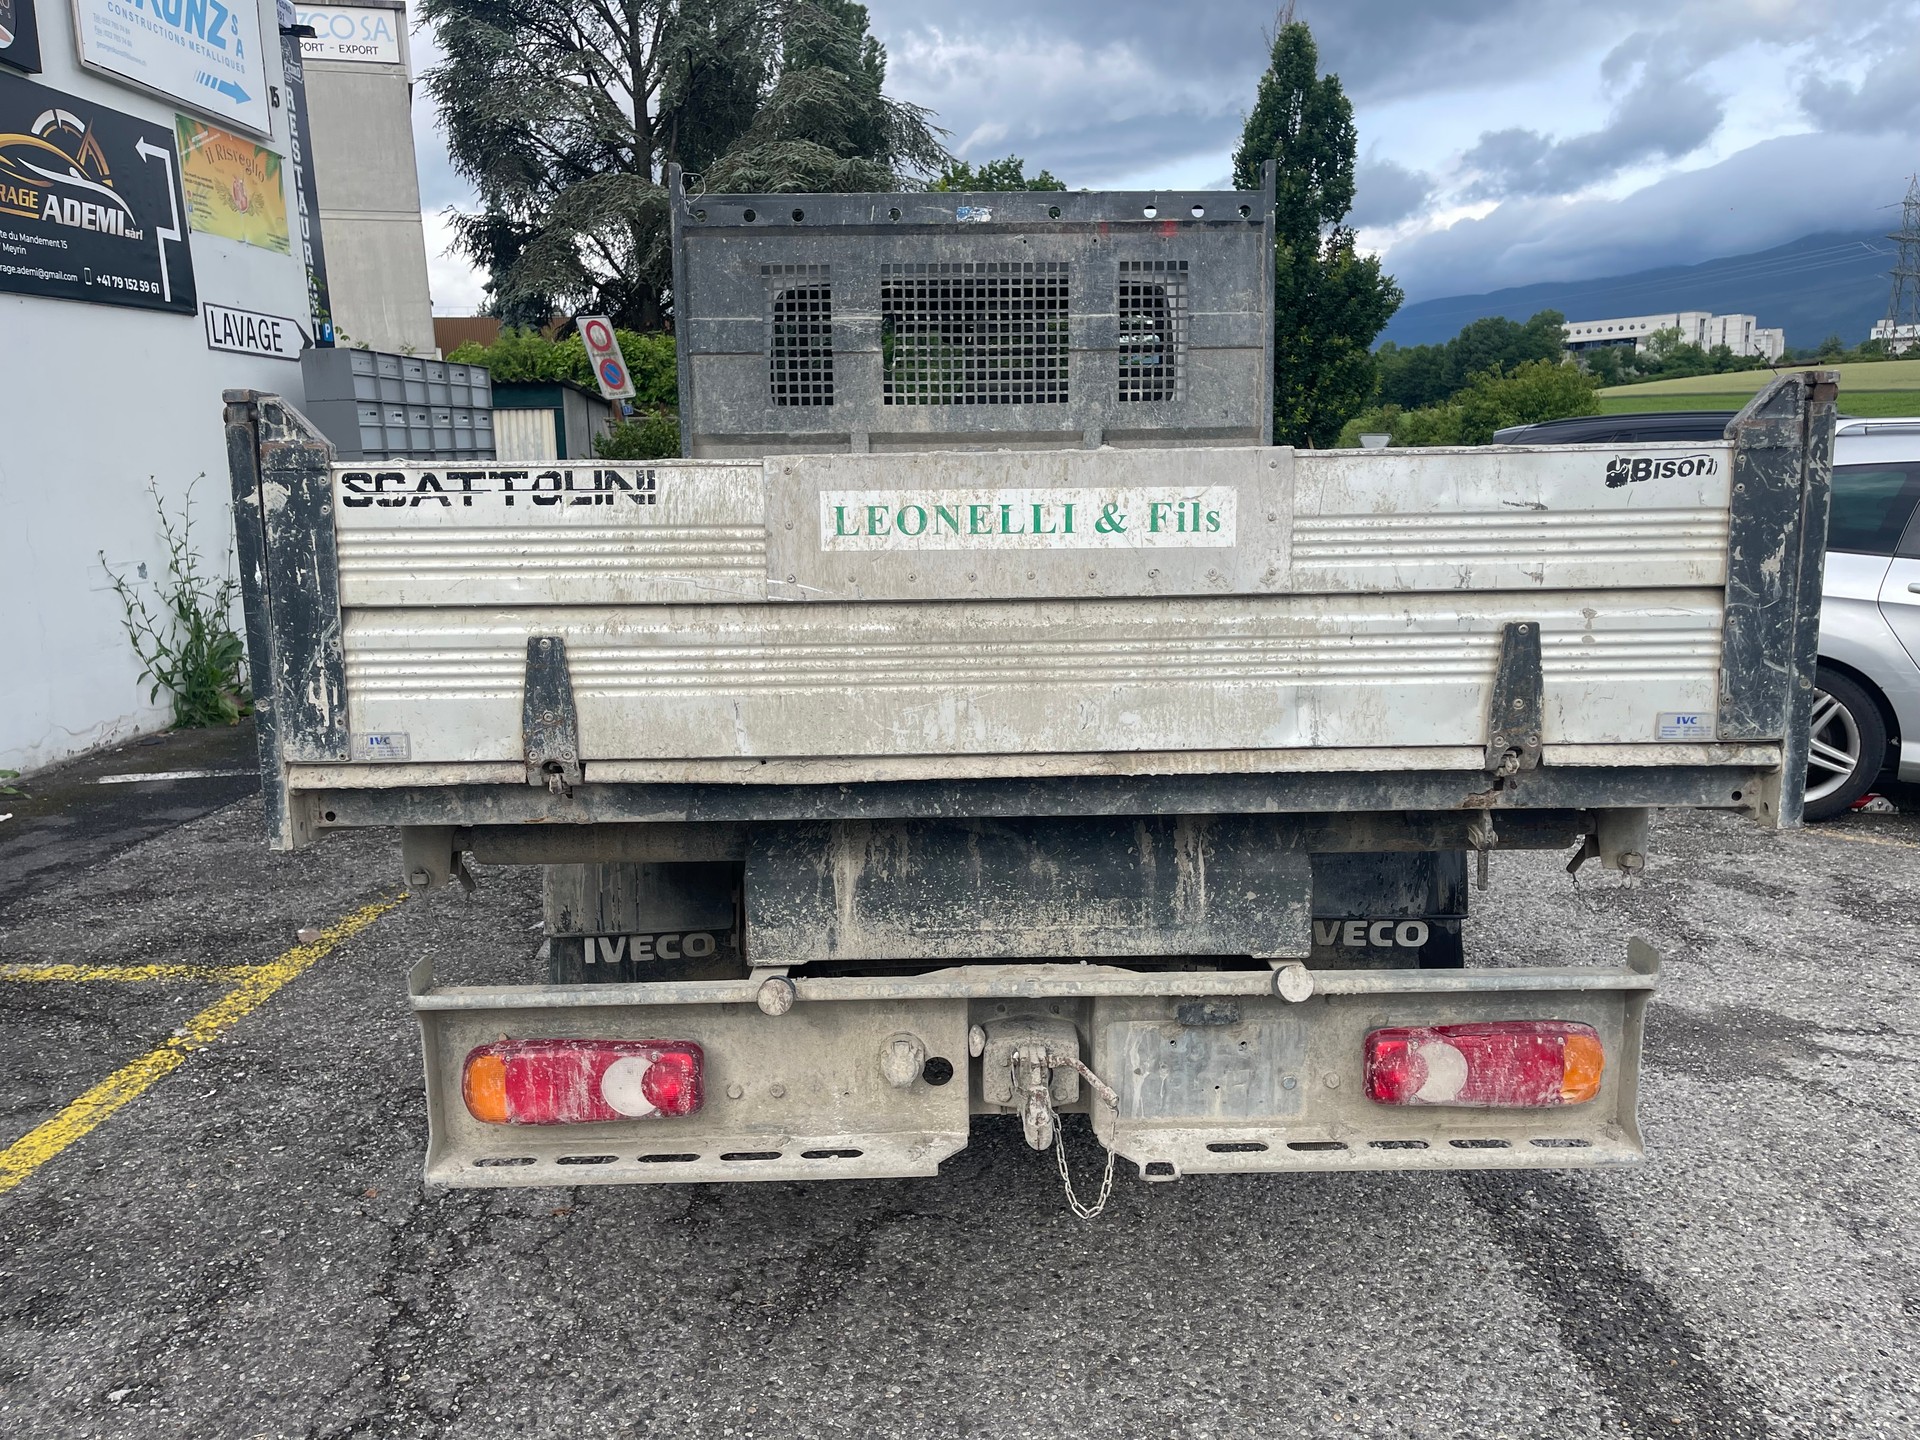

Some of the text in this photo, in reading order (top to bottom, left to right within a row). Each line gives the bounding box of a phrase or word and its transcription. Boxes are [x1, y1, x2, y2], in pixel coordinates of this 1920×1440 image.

[107, 1, 186, 47] CONSTRUCTIONS
[339, 44, 379, 55] EXPORT
[41, 194, 125, 237] ADEMI
[2, 242, 27, 256] Meyrin
[8, 230, 19, 241] du
[19, 232, 61, 249] Mandement
[60, 240, 68, 250] 15
[210, 310, 284, 353] LAVAGE
[341, 469, 657, 508] SCATTOLINI
[834, 500, 1221, 537] LEONELLI & Fils
[1676, 716, 1698, 725] IVC
[369, 736, 391, 745] IVC
[583, 932, 716, 964] IVECO
